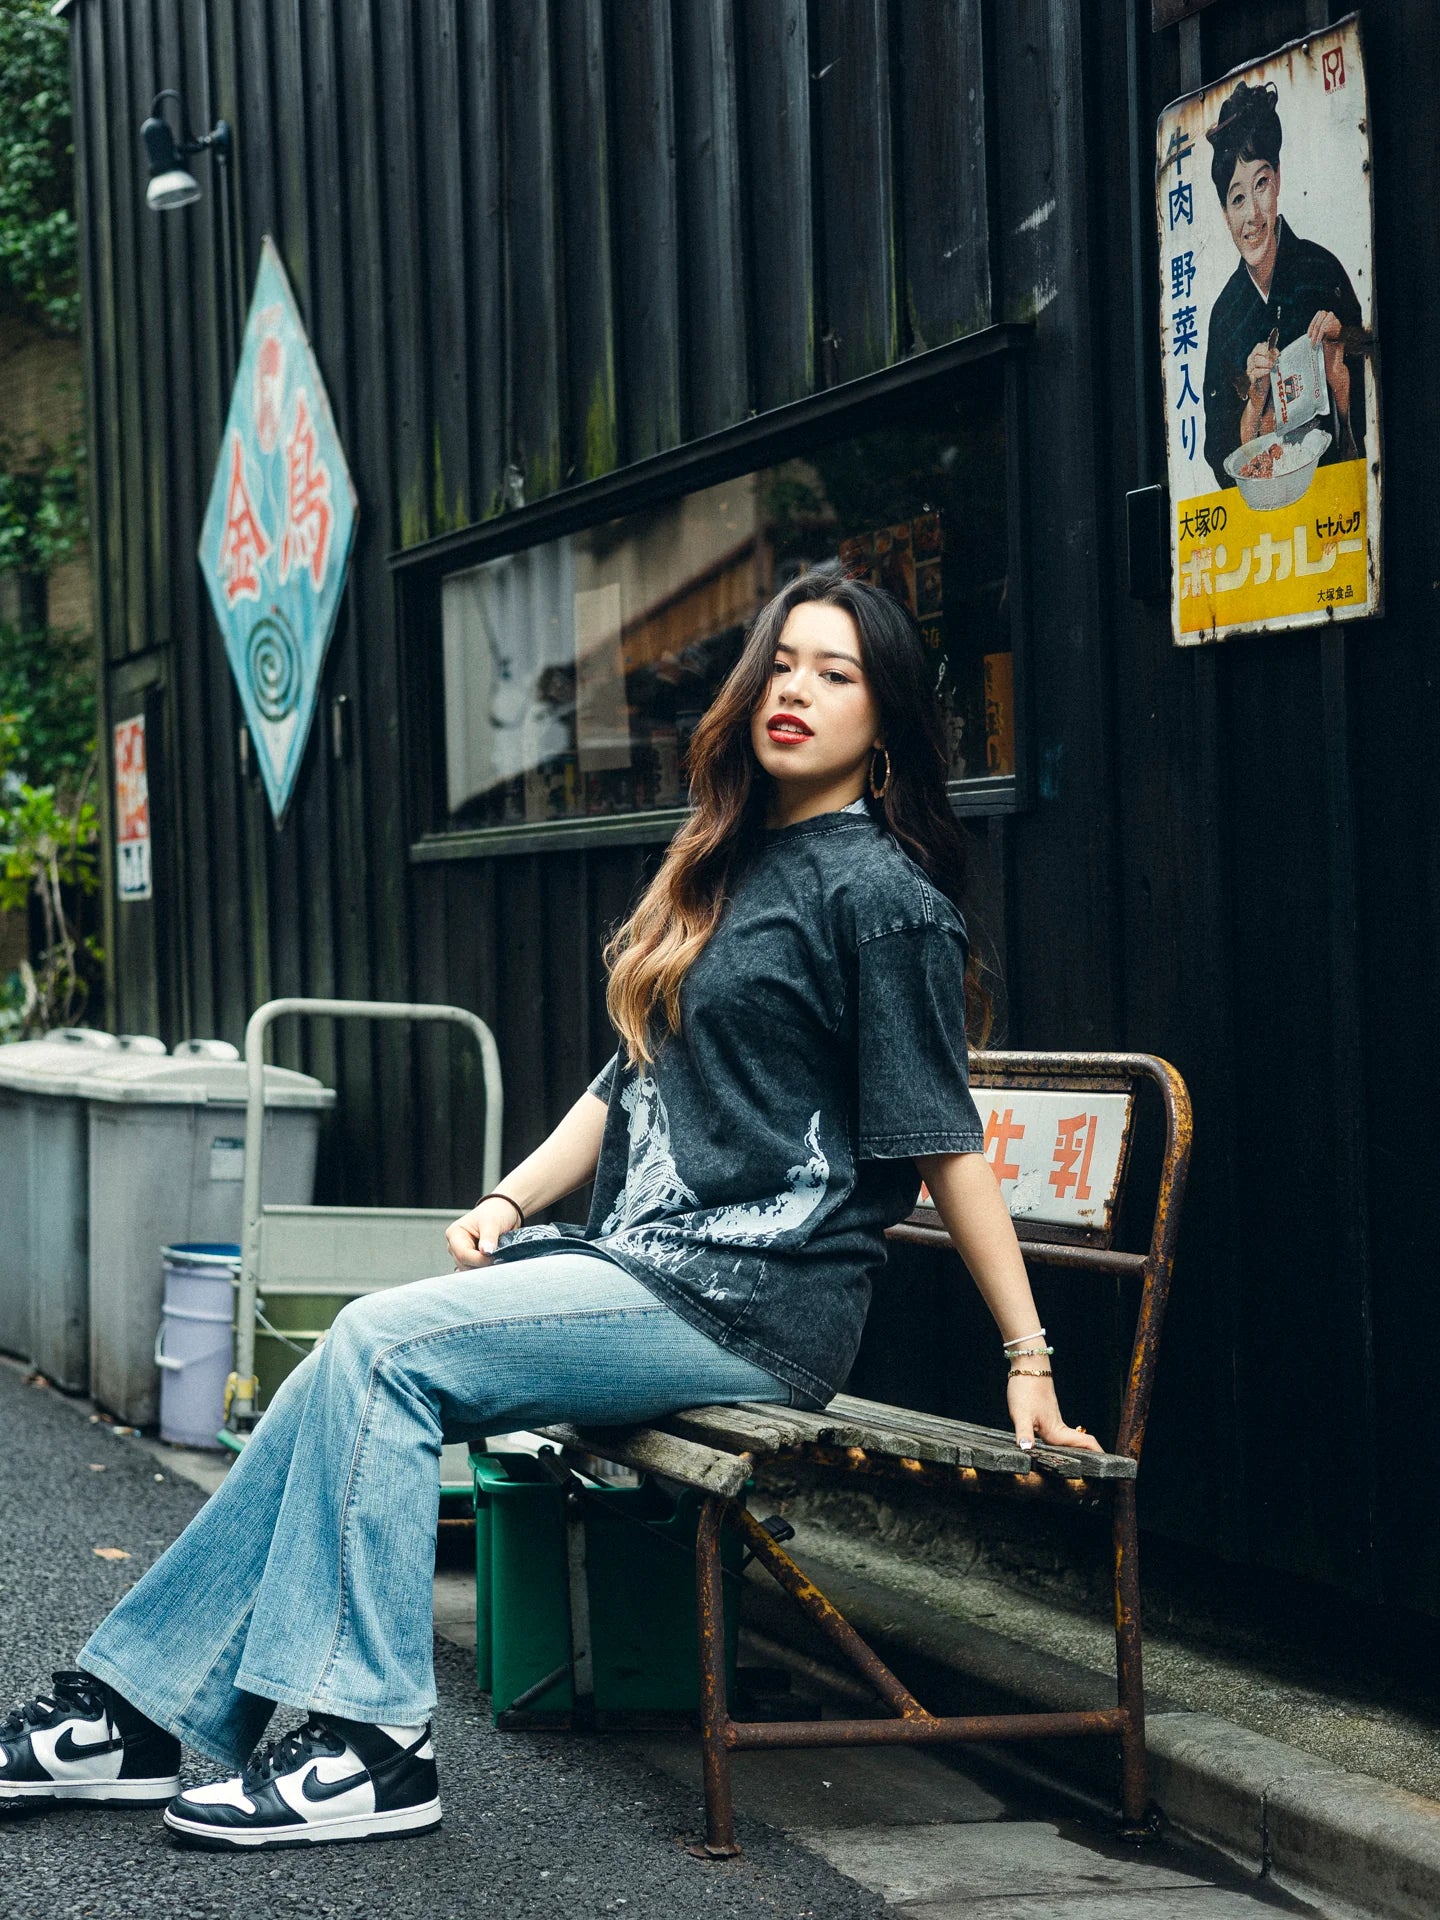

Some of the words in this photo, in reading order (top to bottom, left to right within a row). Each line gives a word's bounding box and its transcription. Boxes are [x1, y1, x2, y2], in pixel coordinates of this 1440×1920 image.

[1166, 125, 1194, 231] 牛肉
[1170, 250, 1201, 461] 野菜入り
[1179, 505, 1228, 541] 大塚の
[1181, 525, 1363, 600] ボンカレー
[1316, 585, 1354, 603] 大塚食品
